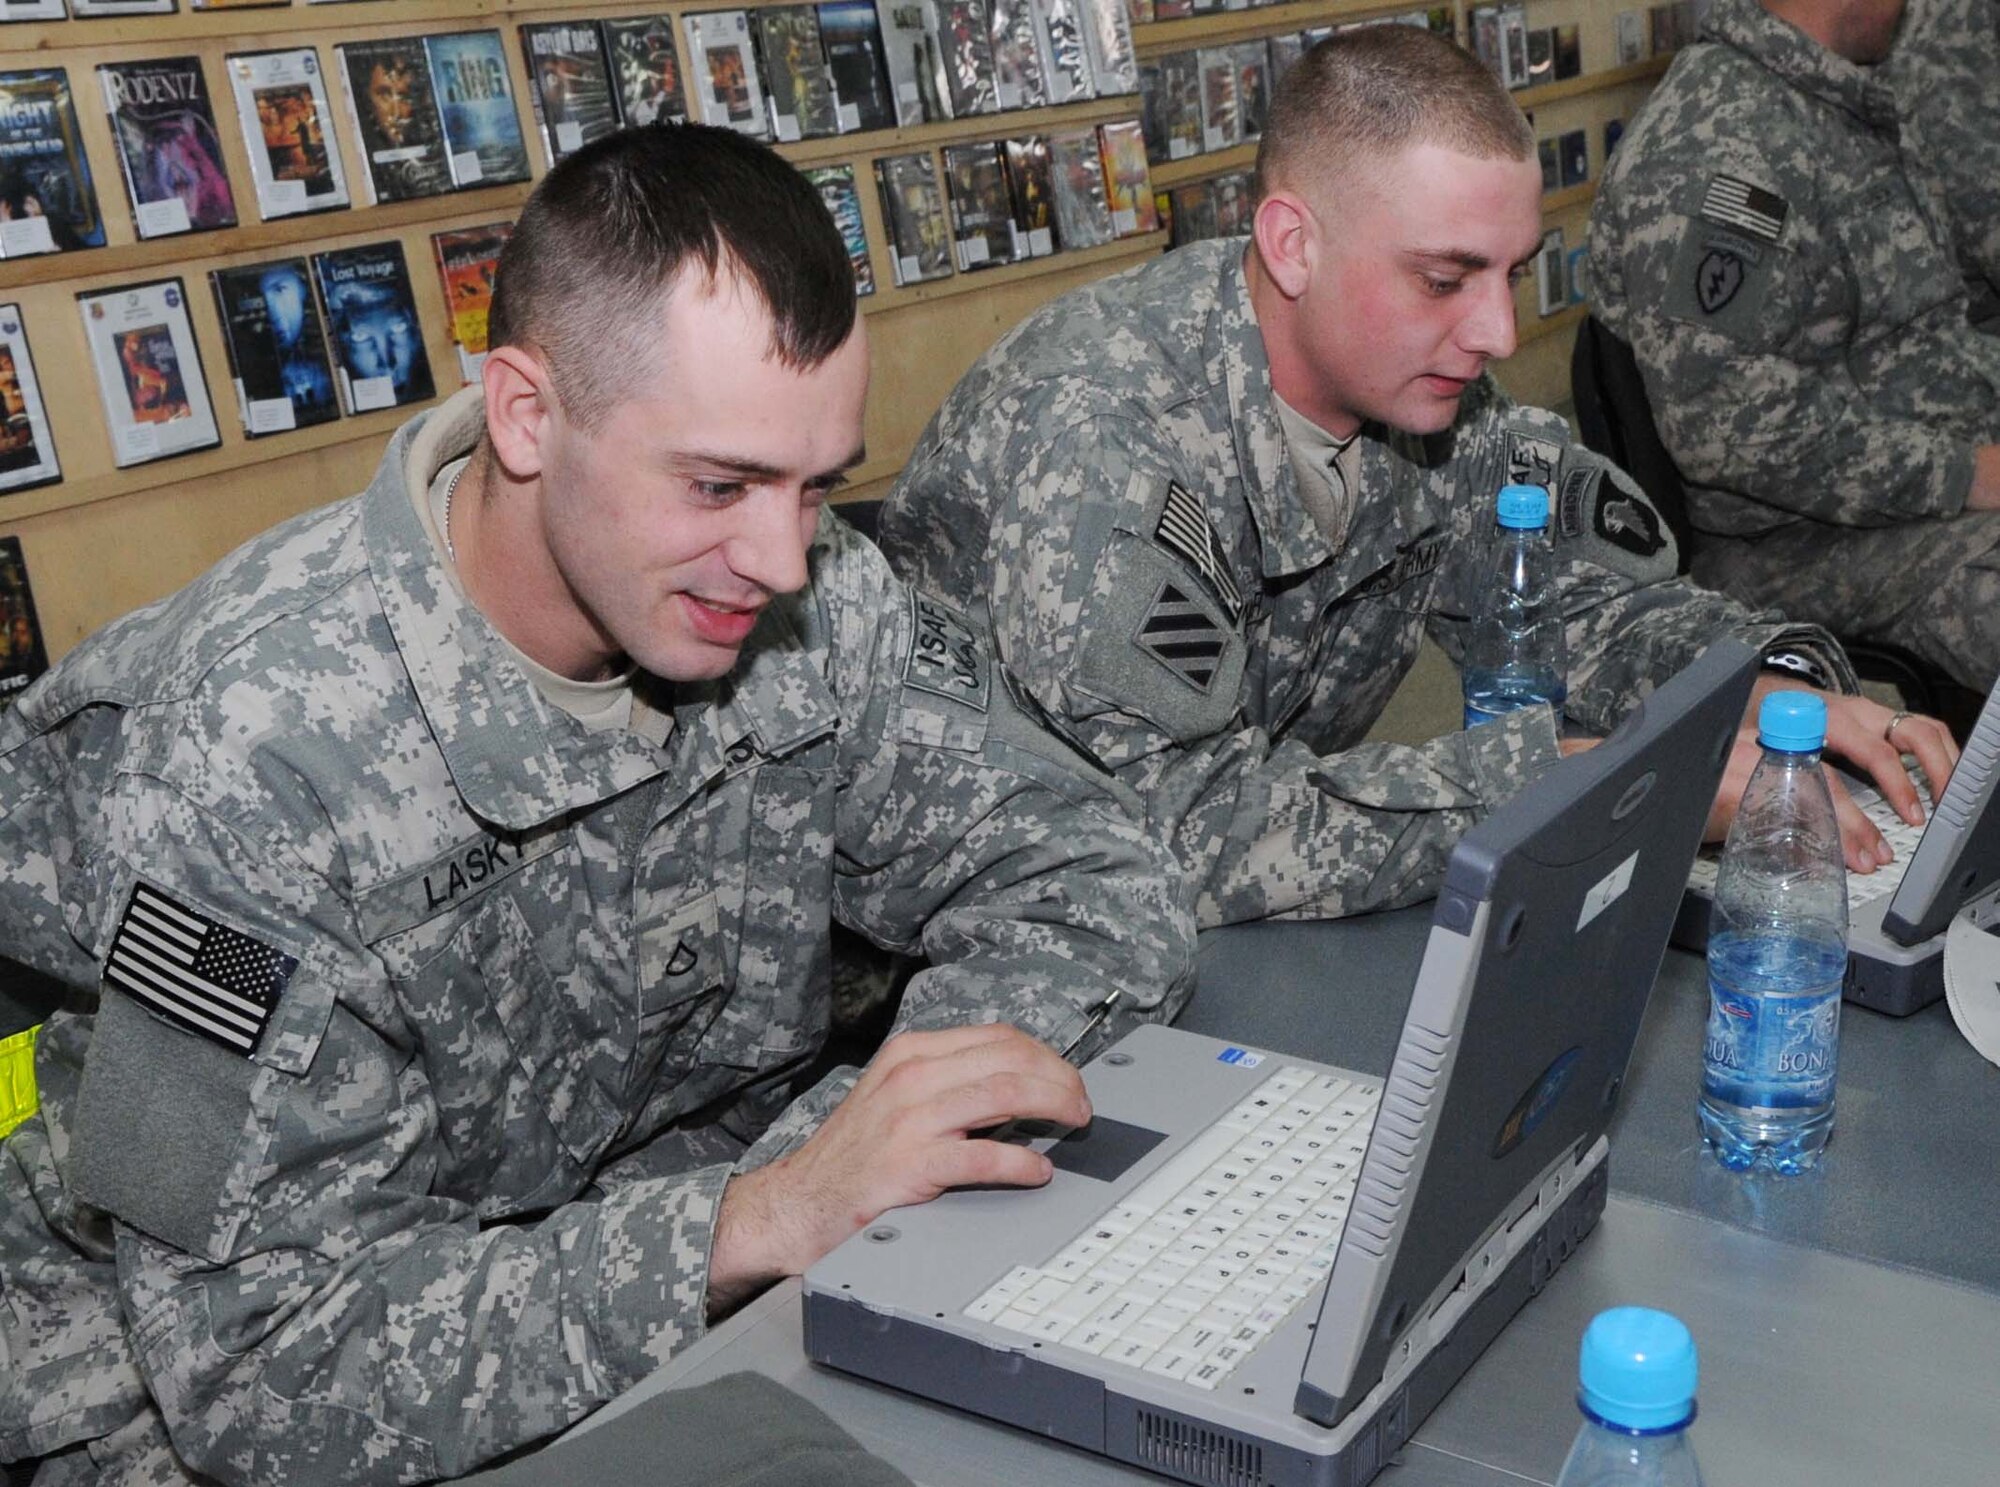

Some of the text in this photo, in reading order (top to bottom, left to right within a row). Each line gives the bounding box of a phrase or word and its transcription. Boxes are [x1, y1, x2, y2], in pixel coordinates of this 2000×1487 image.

[107, 70, 198, 108] RODENTZ
[331, 261, 394, 281] Lost Voyage
[1511, 449, 1531, 486] AF
[917, 602, 948, 668] ISAF
